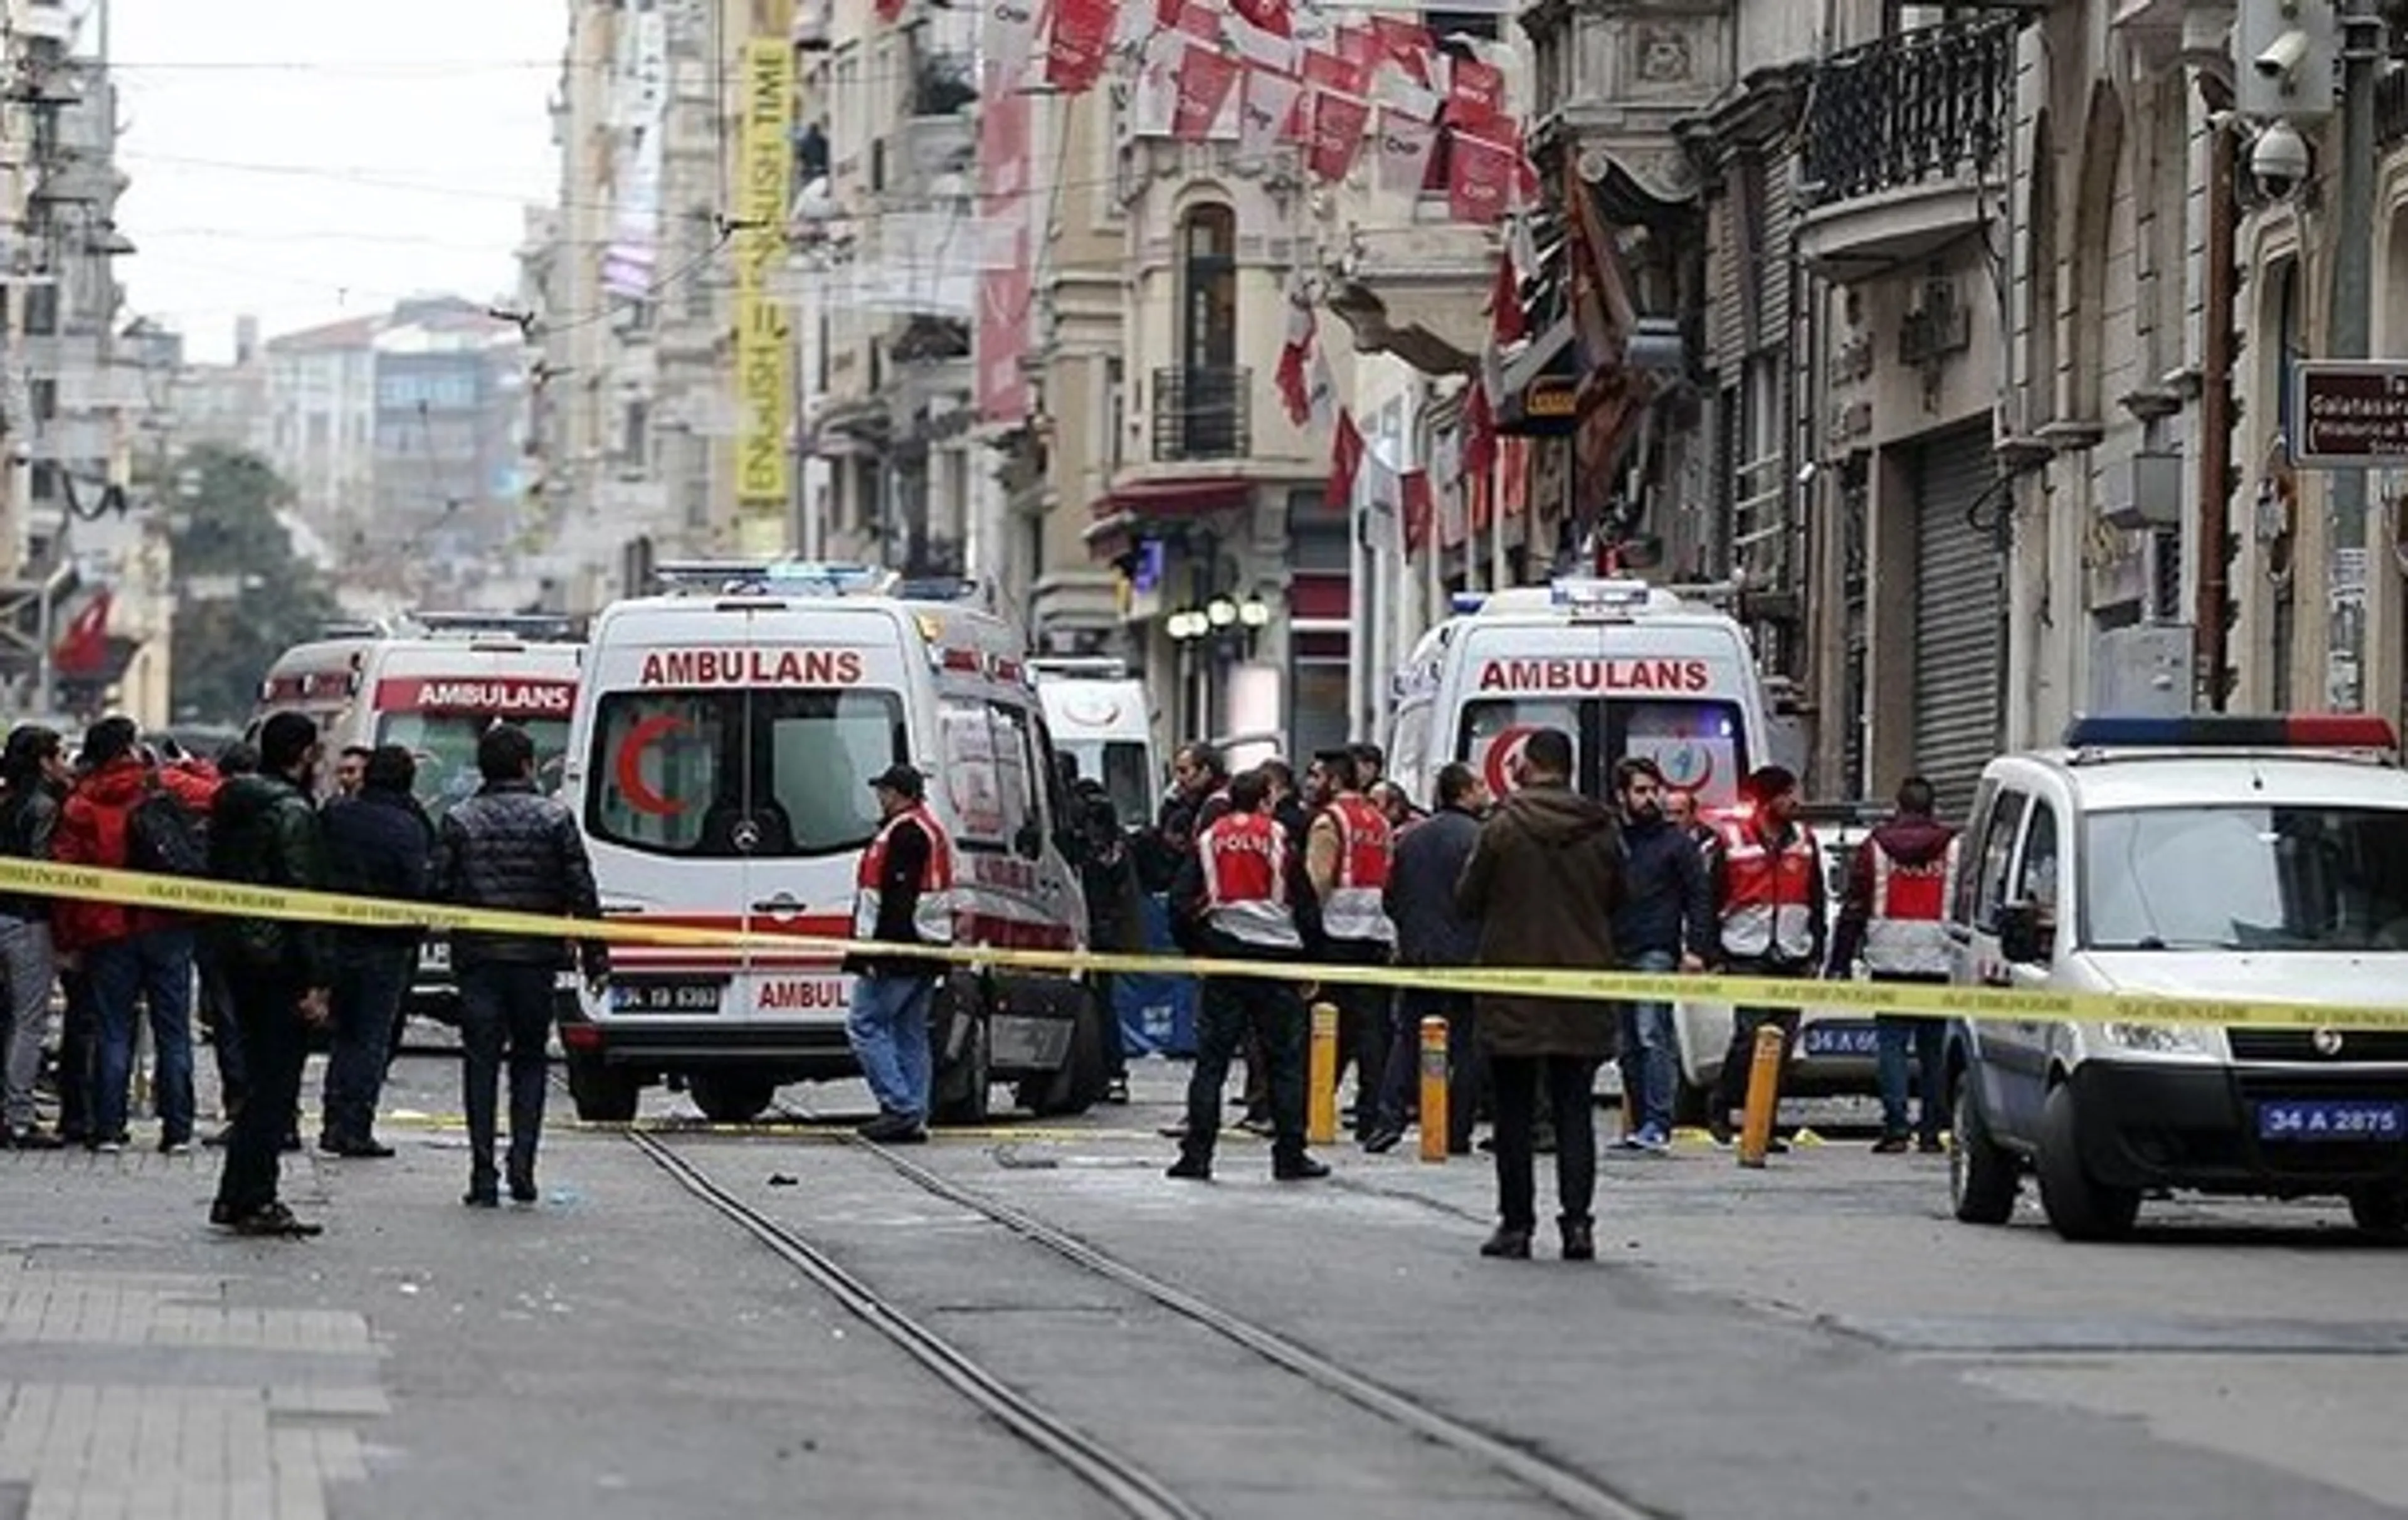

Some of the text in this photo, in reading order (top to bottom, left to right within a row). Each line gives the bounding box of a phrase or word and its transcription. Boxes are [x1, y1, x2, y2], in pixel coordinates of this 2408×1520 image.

[752, 54, 783, 127] TIME
[750, 142, 782, 288] NGLISH
[641, 650, 863, 685] AMBULANS
[1480, 661, 1708, 690] AMBULANS
[418, 683, 570, 707] AMBULANS
[759, 981, 850, 1008] AMBUL
[1837, 1031, 1853, 1051] A
[2269, 1109, 2396, 1131] 34 A 2875
